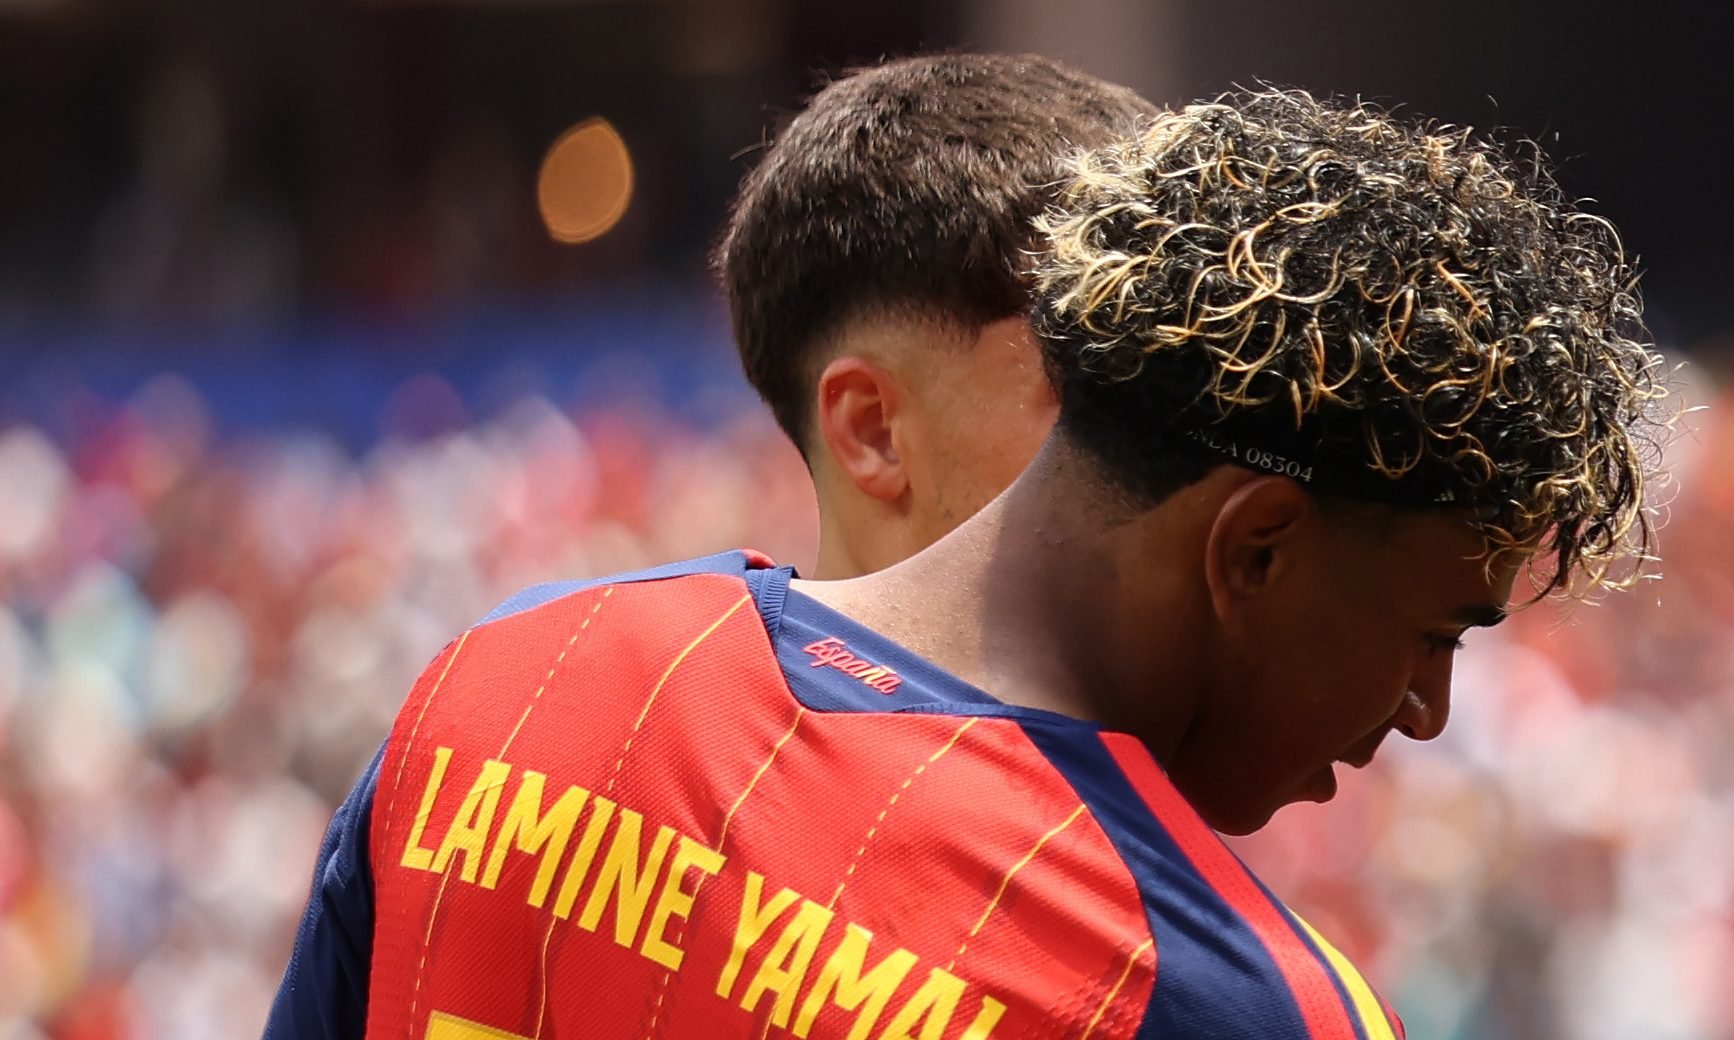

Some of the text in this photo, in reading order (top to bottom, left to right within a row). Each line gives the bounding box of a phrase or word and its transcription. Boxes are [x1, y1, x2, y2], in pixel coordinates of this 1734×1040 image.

[1246, 447, 1313, 482] 08304
[802, 636, 903, 695] España
[400, 746, 727, 972] LAMINE
